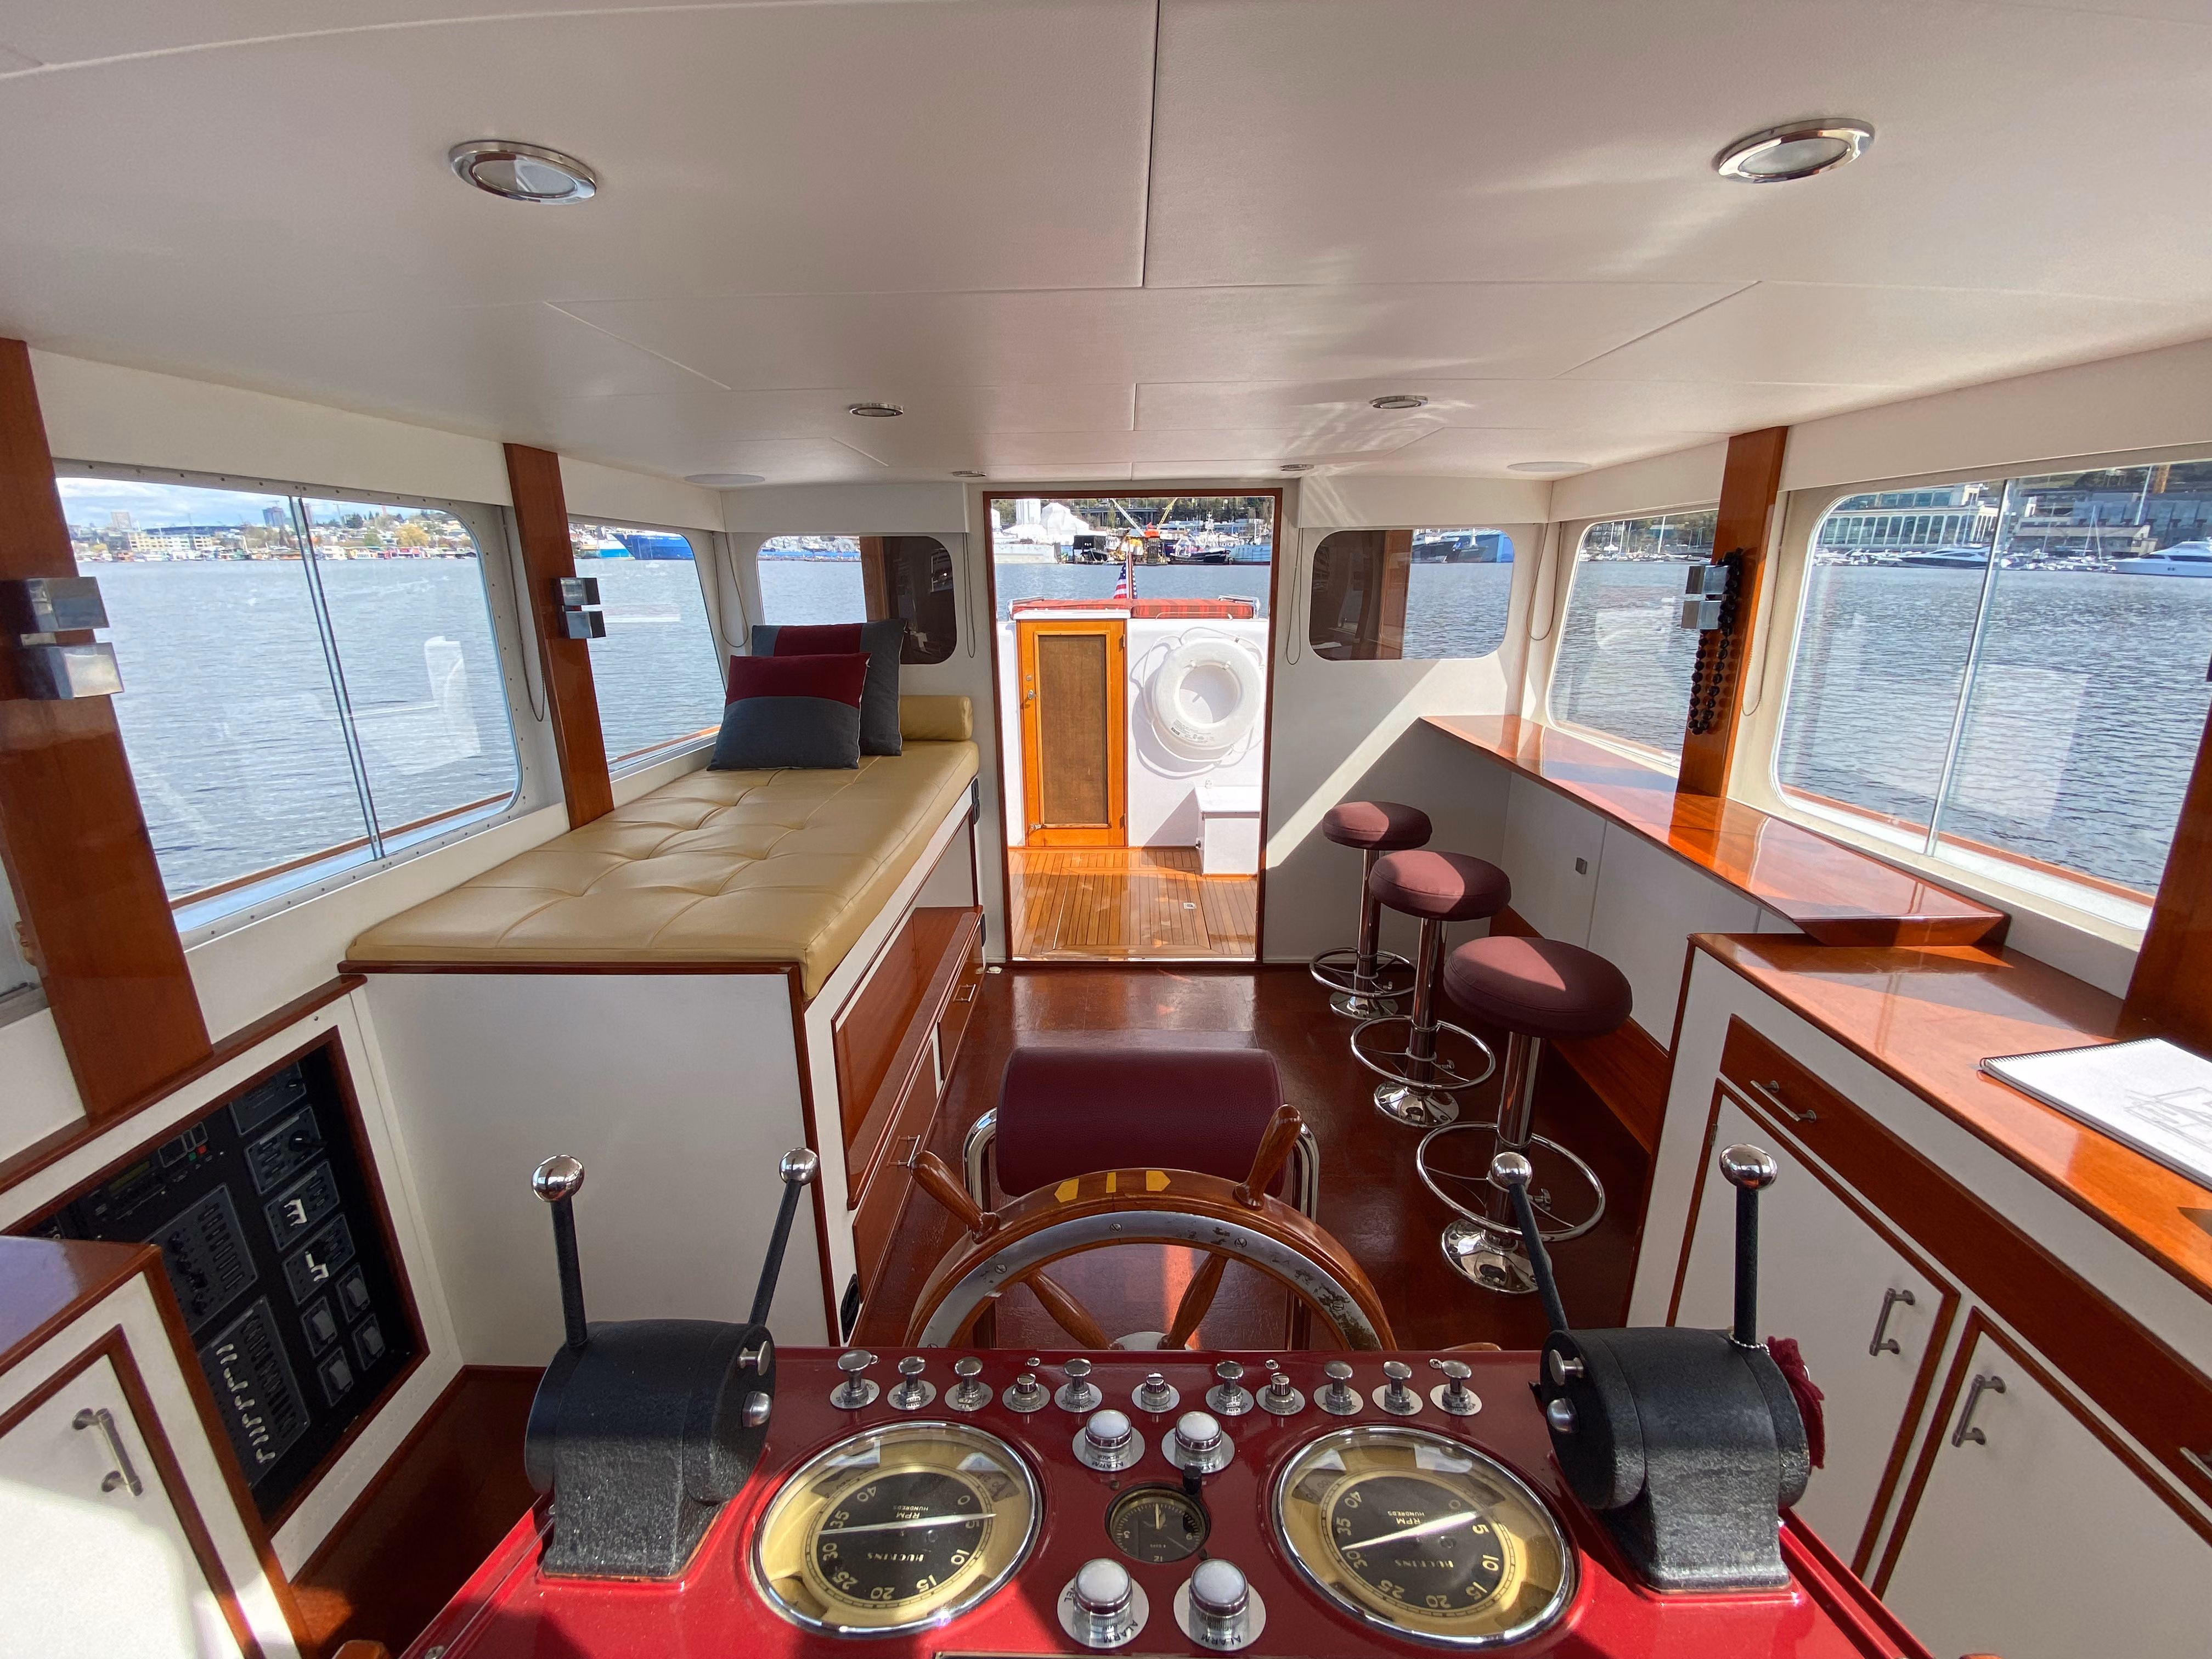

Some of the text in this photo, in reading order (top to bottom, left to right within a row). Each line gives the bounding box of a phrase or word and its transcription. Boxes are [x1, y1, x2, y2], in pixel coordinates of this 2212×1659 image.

[856, 1486, 877, 1502] 40
[957, 1495, 970, 1505] 0
[1344, 1490, 1362, 1509] 40
[1448, 1499, 1462, 1510] 0
[829, 1510, 850, 1529] 35
[1335, 1516, 1352, 1537] 35
[1472, 1523, 1489, 1534] 5
[1124, 1530, 1131, 1539] 3
[822, 1542, 838, 1561] 30
[866, 1551, 924, 1562] HUCKINS
[950, 1549, 970, 1566] 10
[1345, 1549, 1368, 1570] 30
[1481, 1554, 1499, 1572] 10
[831, 1570, 858, 1591] 25
[915, 1574, 938, 1594] 15
[1377, 1579, 1405, 1599] 25
[870, 1586, 895, 1600] 20
[1465, 1581, 1488, 1599] 15
[1425, 1594, 1452, 1609] 20
[1103, 1619, 1138, 1644] ALARM
[1200, 1633, 1242, 1646] ALARM
